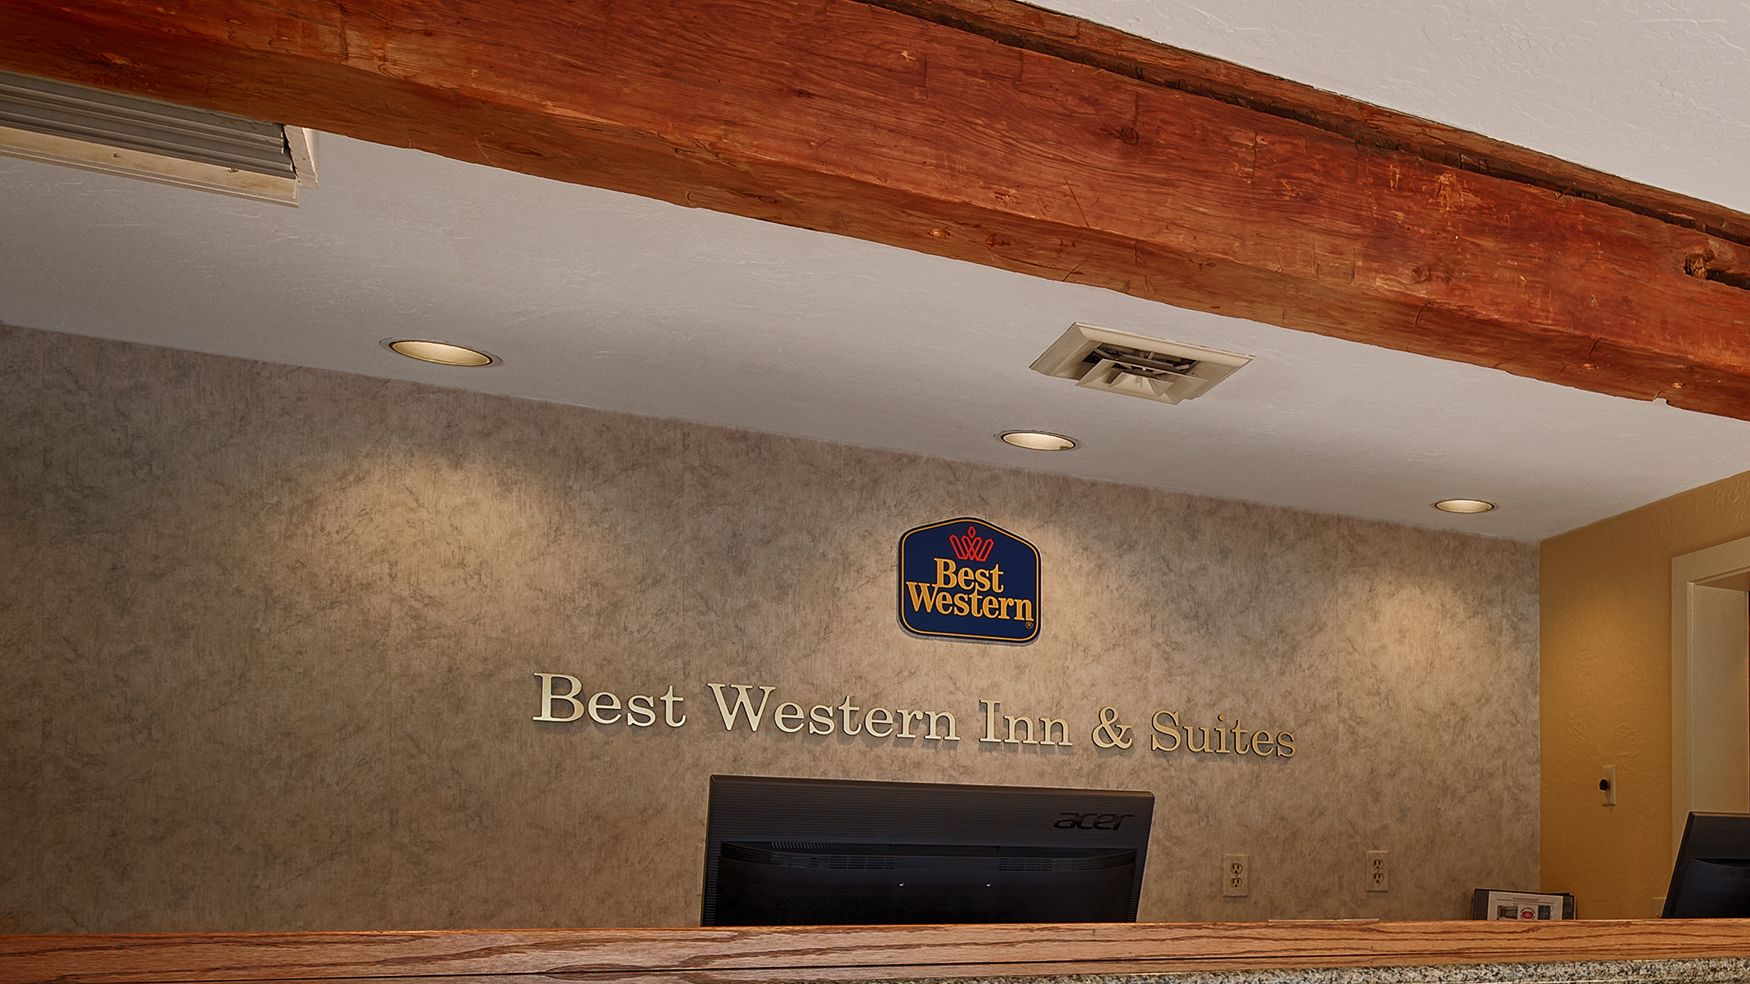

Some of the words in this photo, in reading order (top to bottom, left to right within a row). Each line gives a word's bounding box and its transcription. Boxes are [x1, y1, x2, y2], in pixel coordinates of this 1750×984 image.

[933, 557, 1004, 593] Best
[906, 581, 1034, 621] Western
[531, 671, 688, 728] Best
[706, 680, 961, 743] Western
[977, 698, 1074, 747] Inn
[1091, 706, 1134, 749] &
[1149, 710, 1297, 759] Suites
[1053, 811, 1135, 831] acer
